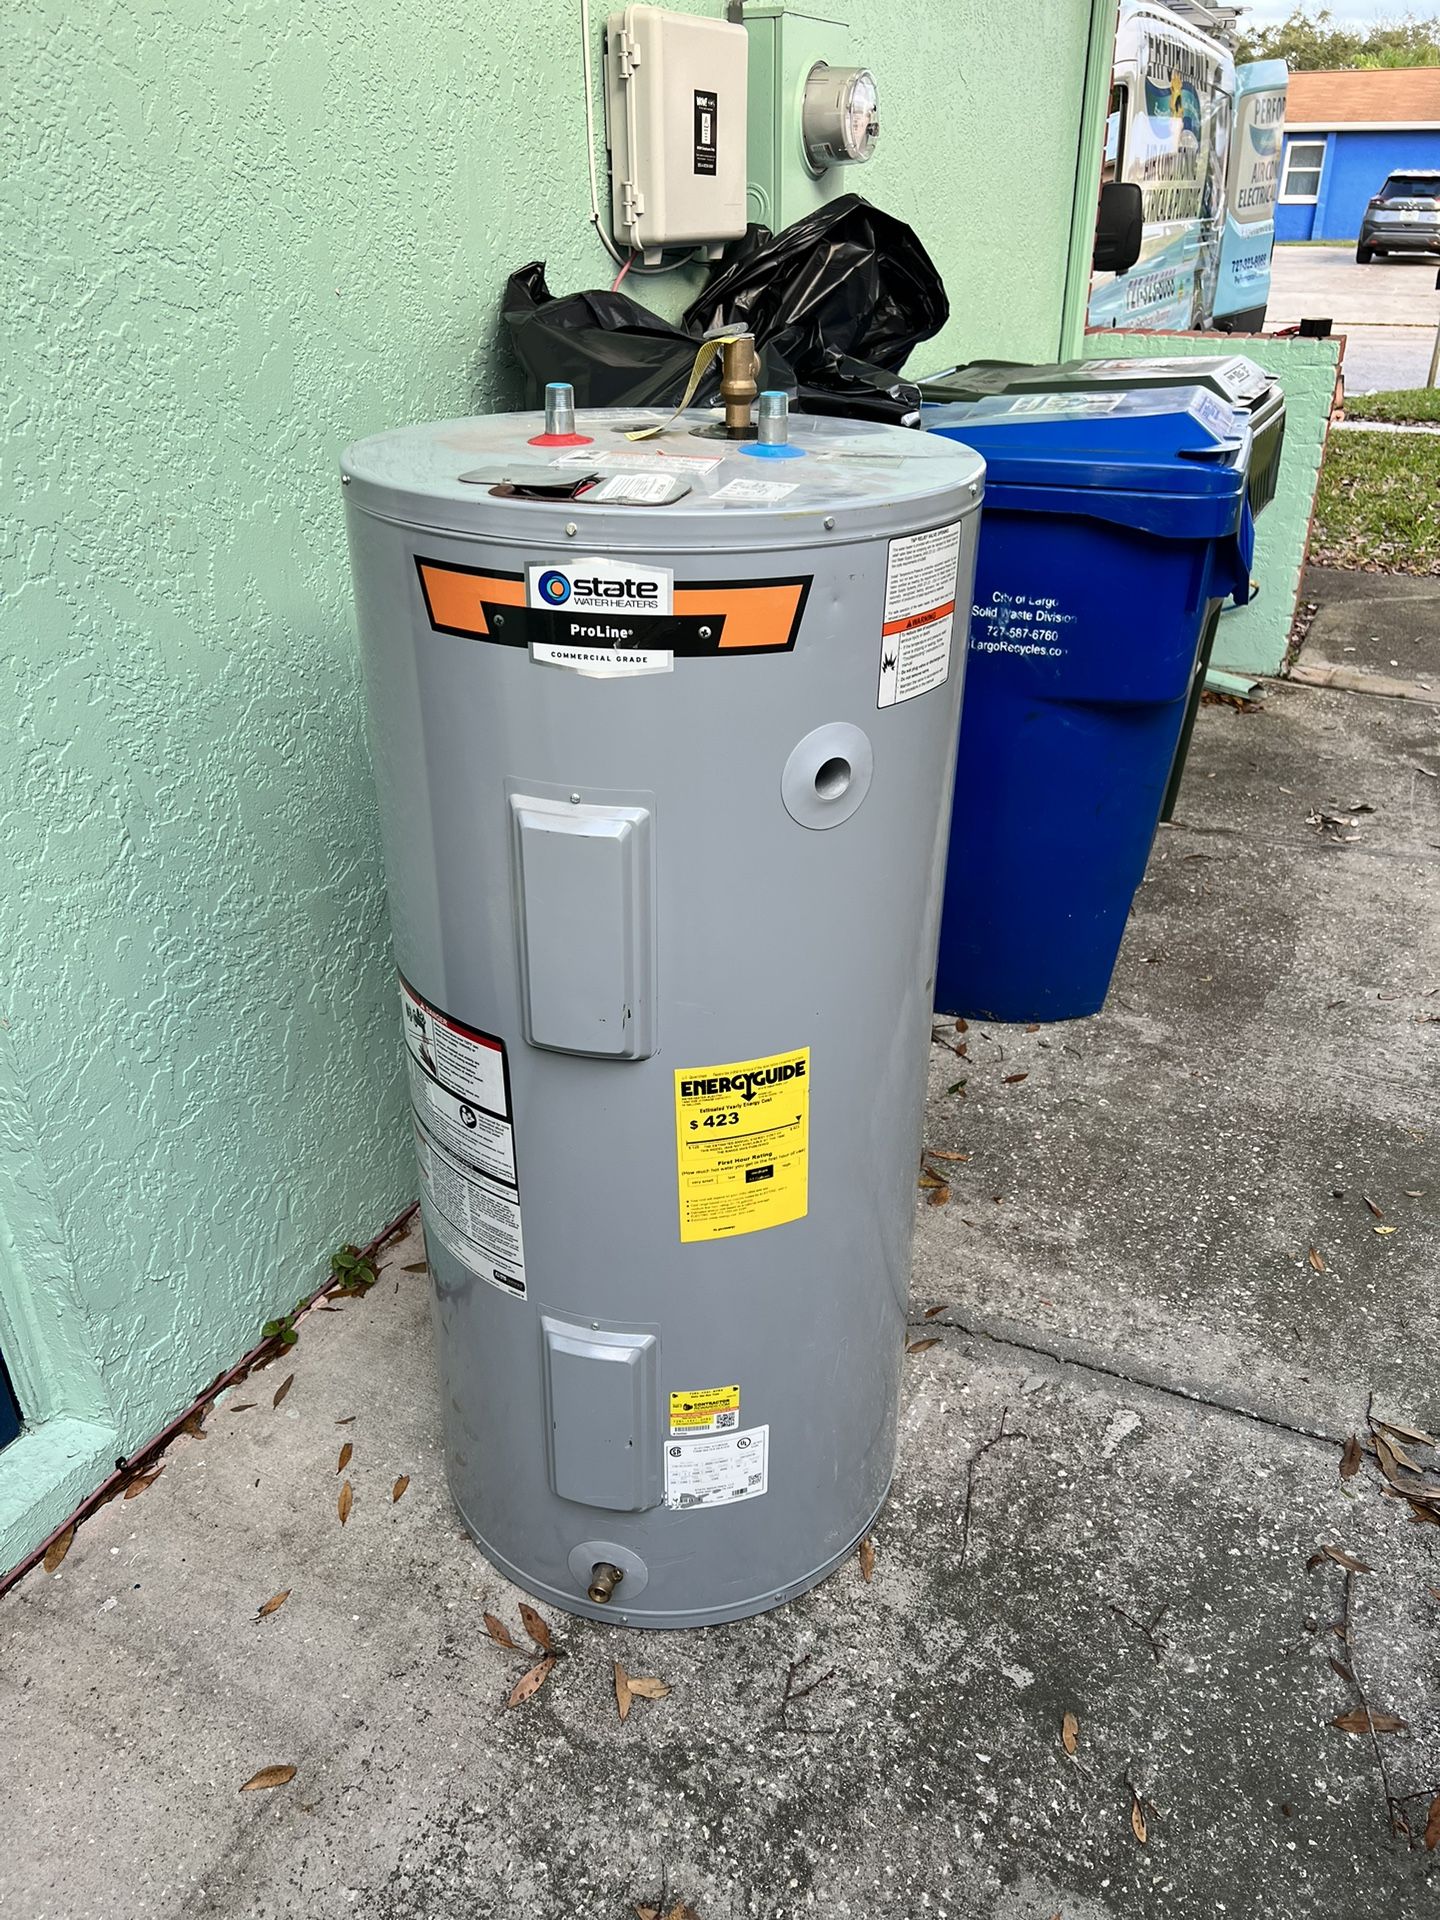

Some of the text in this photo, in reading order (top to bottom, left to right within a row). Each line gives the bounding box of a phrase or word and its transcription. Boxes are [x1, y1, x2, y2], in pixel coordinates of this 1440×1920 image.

[573, 577, 659, 599] state
[574, 597, 658, 609] WATER HEATERS
[971, 605, 998, 618] Solid
[1000, 607, 1033, 621] Waste
[986, 626, 1059, 642] 727-587-6760
[550, 651, 648, 664] COMMERCIAL GRADE
[681, 1060, 806, 1101] ENERGYGUIDE
[726, 1103, 742, 1111] Yearly
[689, 1112, 740, 1131] $ 423
